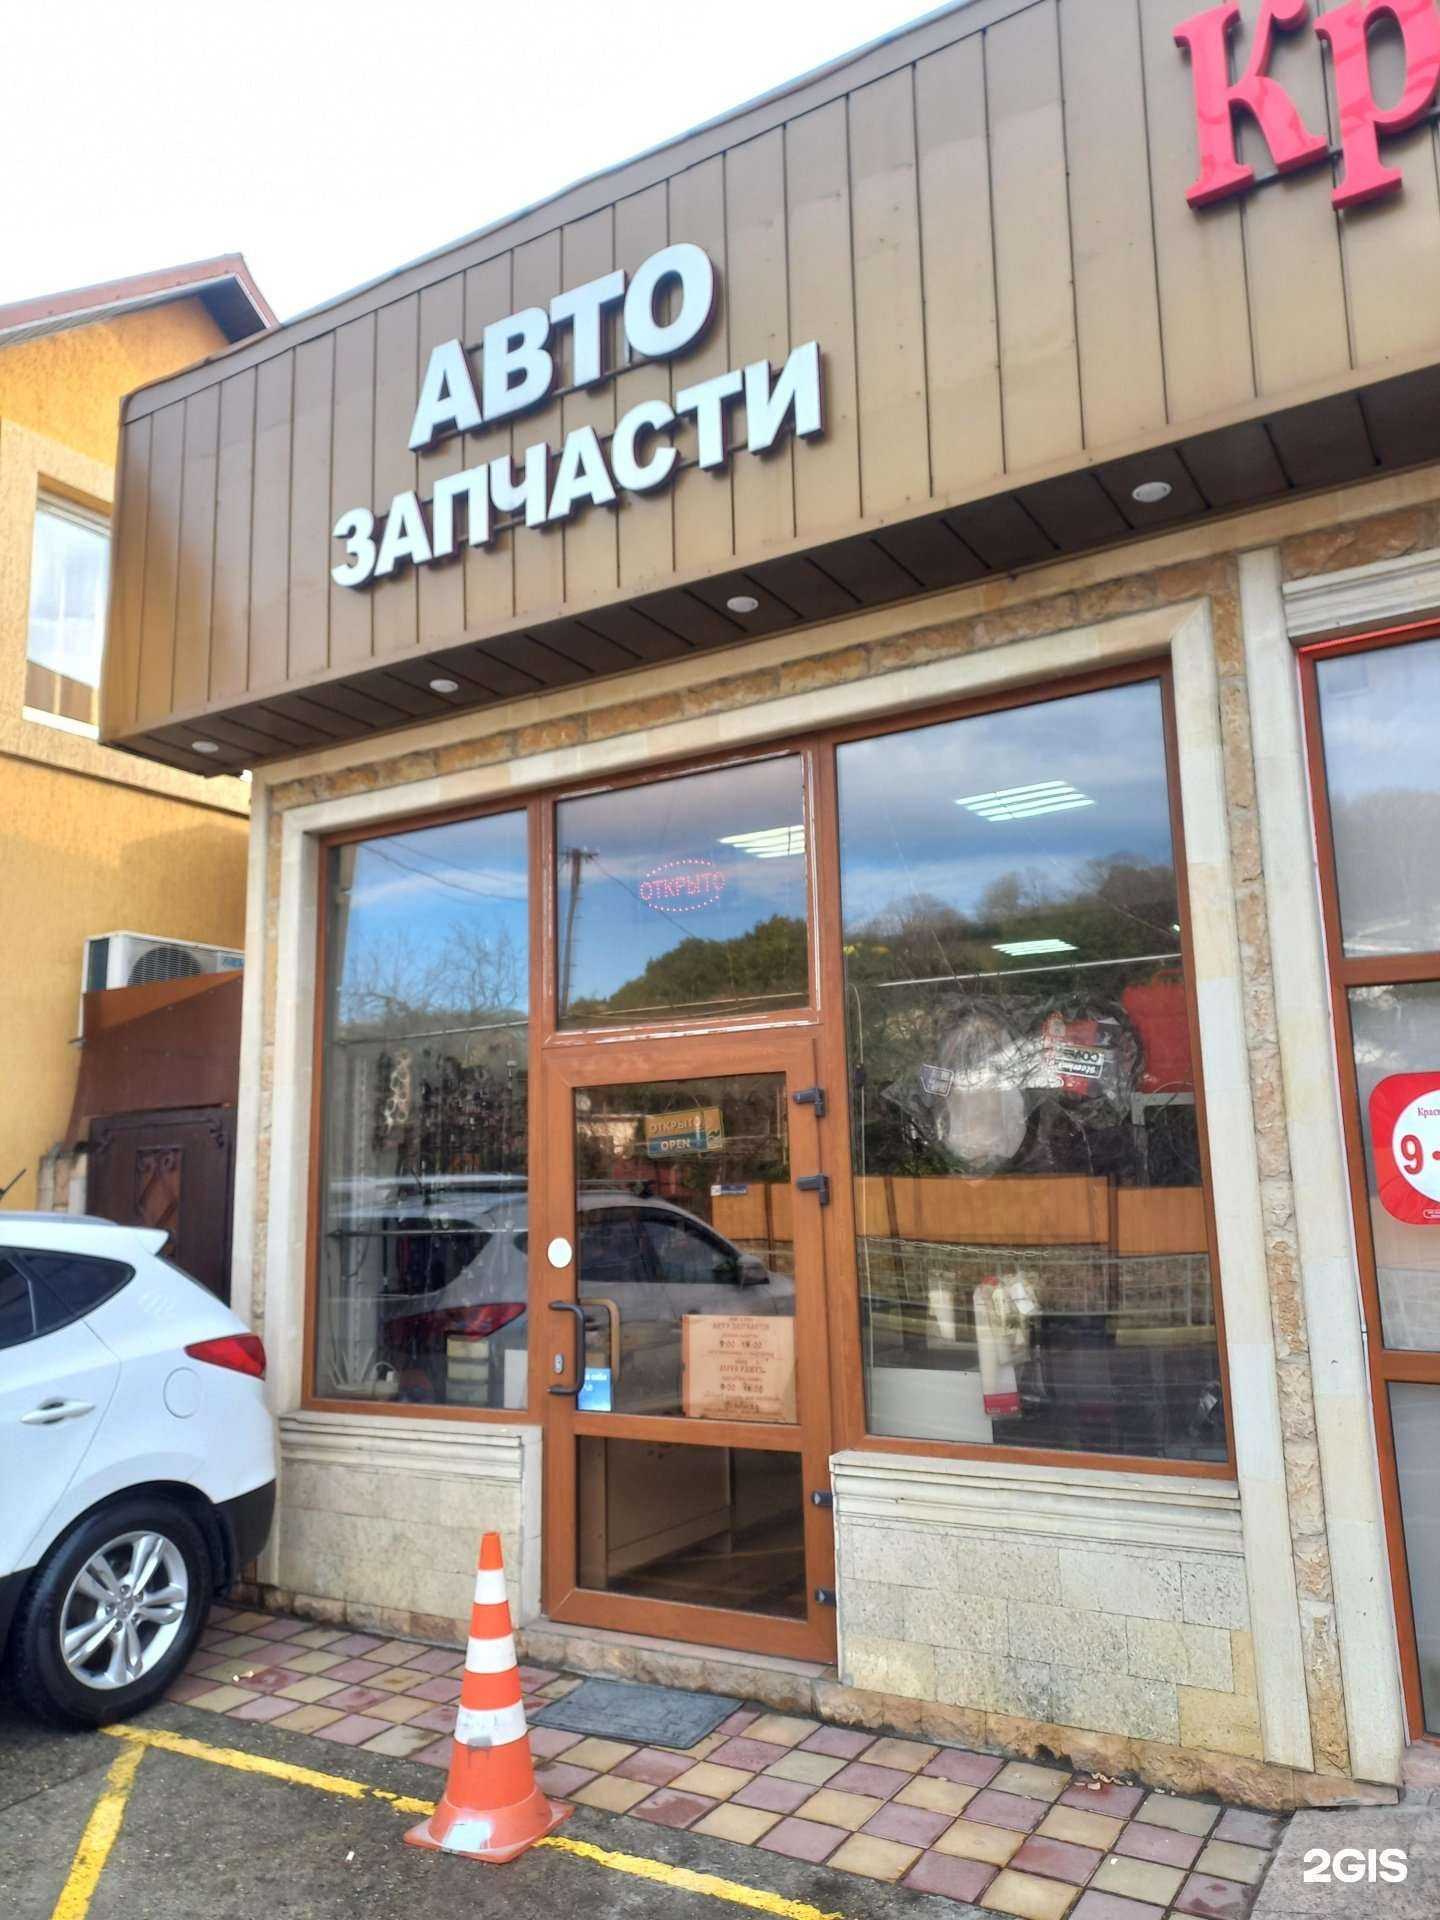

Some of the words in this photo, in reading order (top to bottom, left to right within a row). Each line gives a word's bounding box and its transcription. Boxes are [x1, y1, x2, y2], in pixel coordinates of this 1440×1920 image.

[408, 242, 715, 451] АВТО
[331, 341, 822, 589] ЗАПЧАСТИ
[660, 1139, 691, 1152] OPEN
